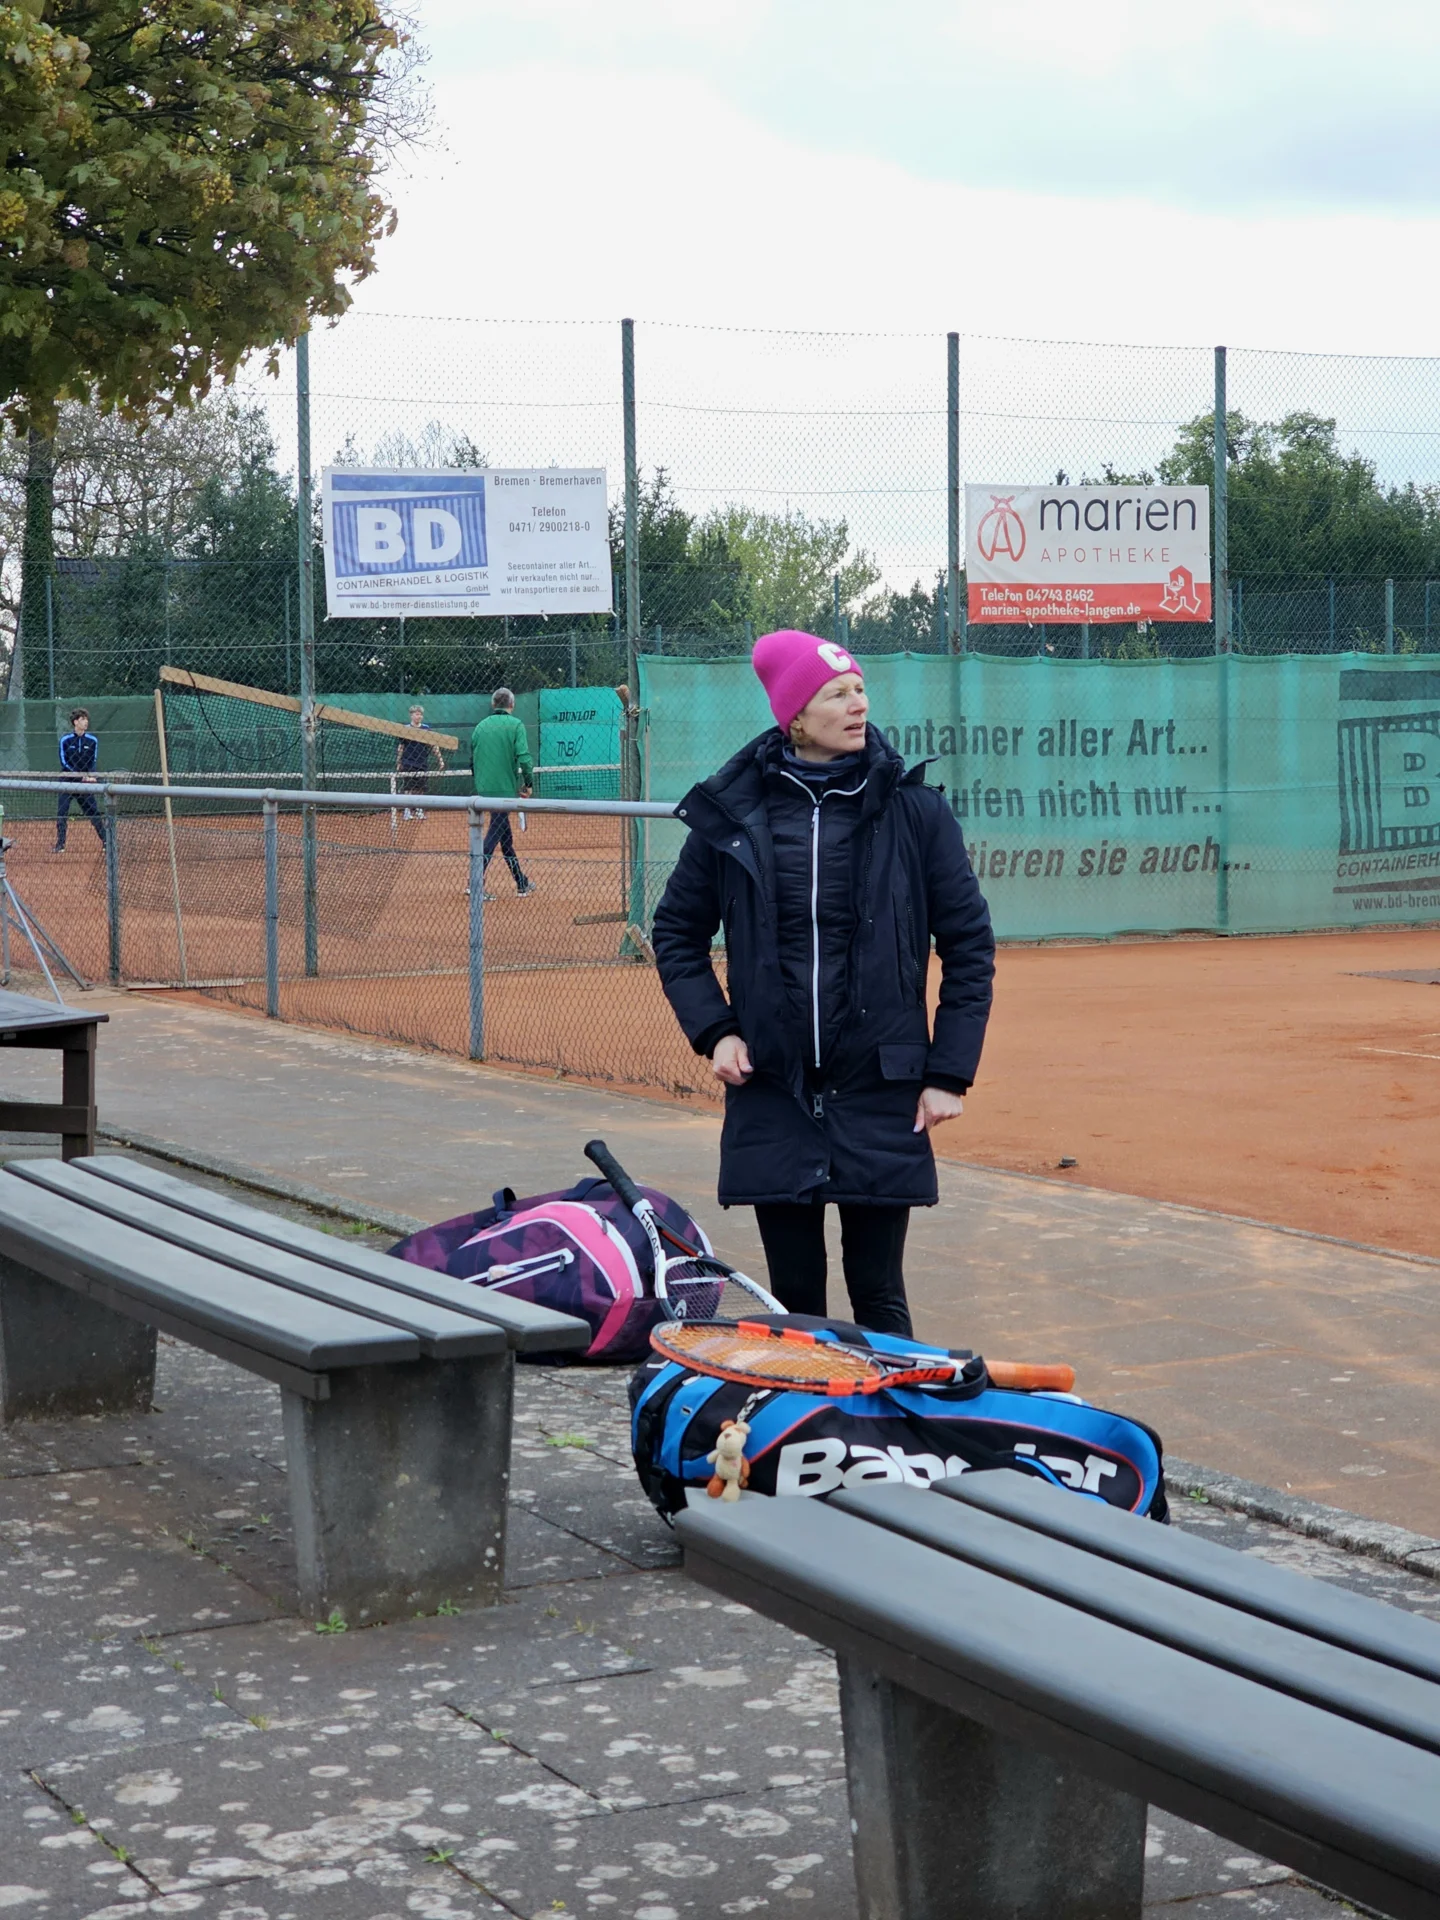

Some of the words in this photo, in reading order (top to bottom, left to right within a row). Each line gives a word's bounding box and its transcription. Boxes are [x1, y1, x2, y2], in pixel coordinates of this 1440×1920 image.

[494, 475, 530, 486] Bremen
[539, 475, 603, 486] Bremerhaven
[531, 506, 567, 517] Telefon
[1039, 498, 1197, 531] marien
[509, 522, 537, 533] 0471/
[539, 521, 591, 533] 2900218-0
[356, 507, 463, 564] BD
[1040, 547, 1170, 563] APOTHEKE
[507, 562, 557, 571] Seecontainer
[558, 561, 577, 570] aller
[336, 575, 432, 591] CONTAINERHANDEL
[435, 574, 442, 583] &
[444, 571, 489, 583] LOGISTIK
[506, 574, 518, 582] wir
[520, 573, 558, 582] verkaufen
[560, 573, 579, 581] nicht
[465, 584, 489, 593] GmbH
[514, 585, 568, 596] transportieren
[569, 585, 580, 593] sie
[980, 588, 1023, 601] Telefon
[1026, 588, 1063, 602] 04743
[1065, 588, 1095, 602] 8462
[349, 600, 480, 610] www.bd-bremer-dienstleistung.de
[980, 602, 1141, 619] marien-apotheke-langen.de
[817, 643, 851, 673] C
[558, 710, 597, 722] DUNLOP
[1037, 719, 1115, 758] aller
[1126, 718, 1208, 757] Art...
[1038, 779, 1122, 818] nicht
[1133, 784, 1222, 817] nur...
[1077, 840, 1127, 876] sie
[1138, 836, 1251, 875] auch...
[640, 1213, 660, 1258] HEAD
